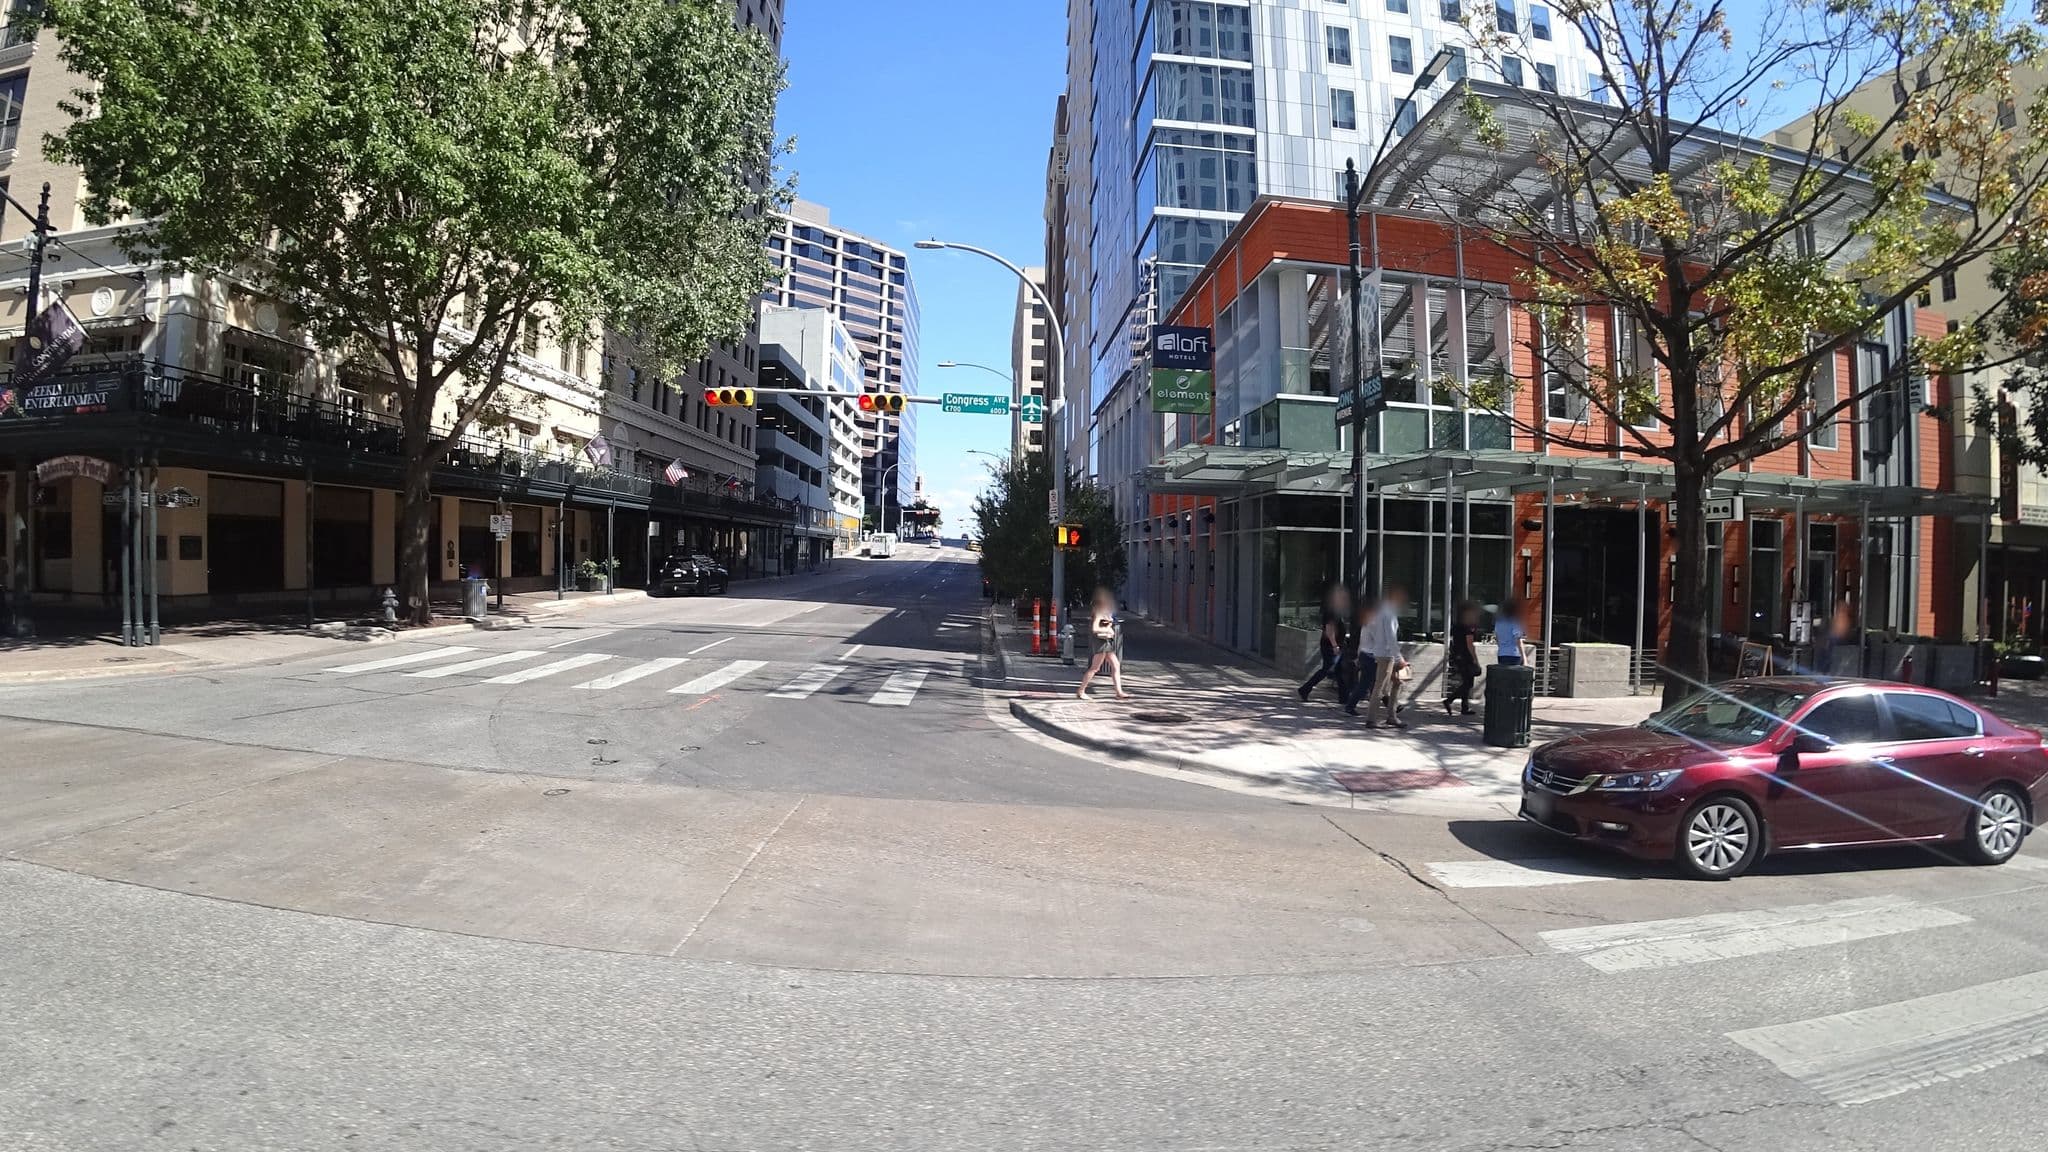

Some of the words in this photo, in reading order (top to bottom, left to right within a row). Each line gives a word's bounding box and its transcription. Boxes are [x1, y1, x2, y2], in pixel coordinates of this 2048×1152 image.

[1157, 333, 1209, 353] aloft
[65, 382, 88, 395] LIVE
[1157, 389, 1209, 400] element
[24, 391, 109, 410] ENTERTAINMENT
[946, 394, 989, 407] Congress
[993, 396, 1006, 404] AVE
